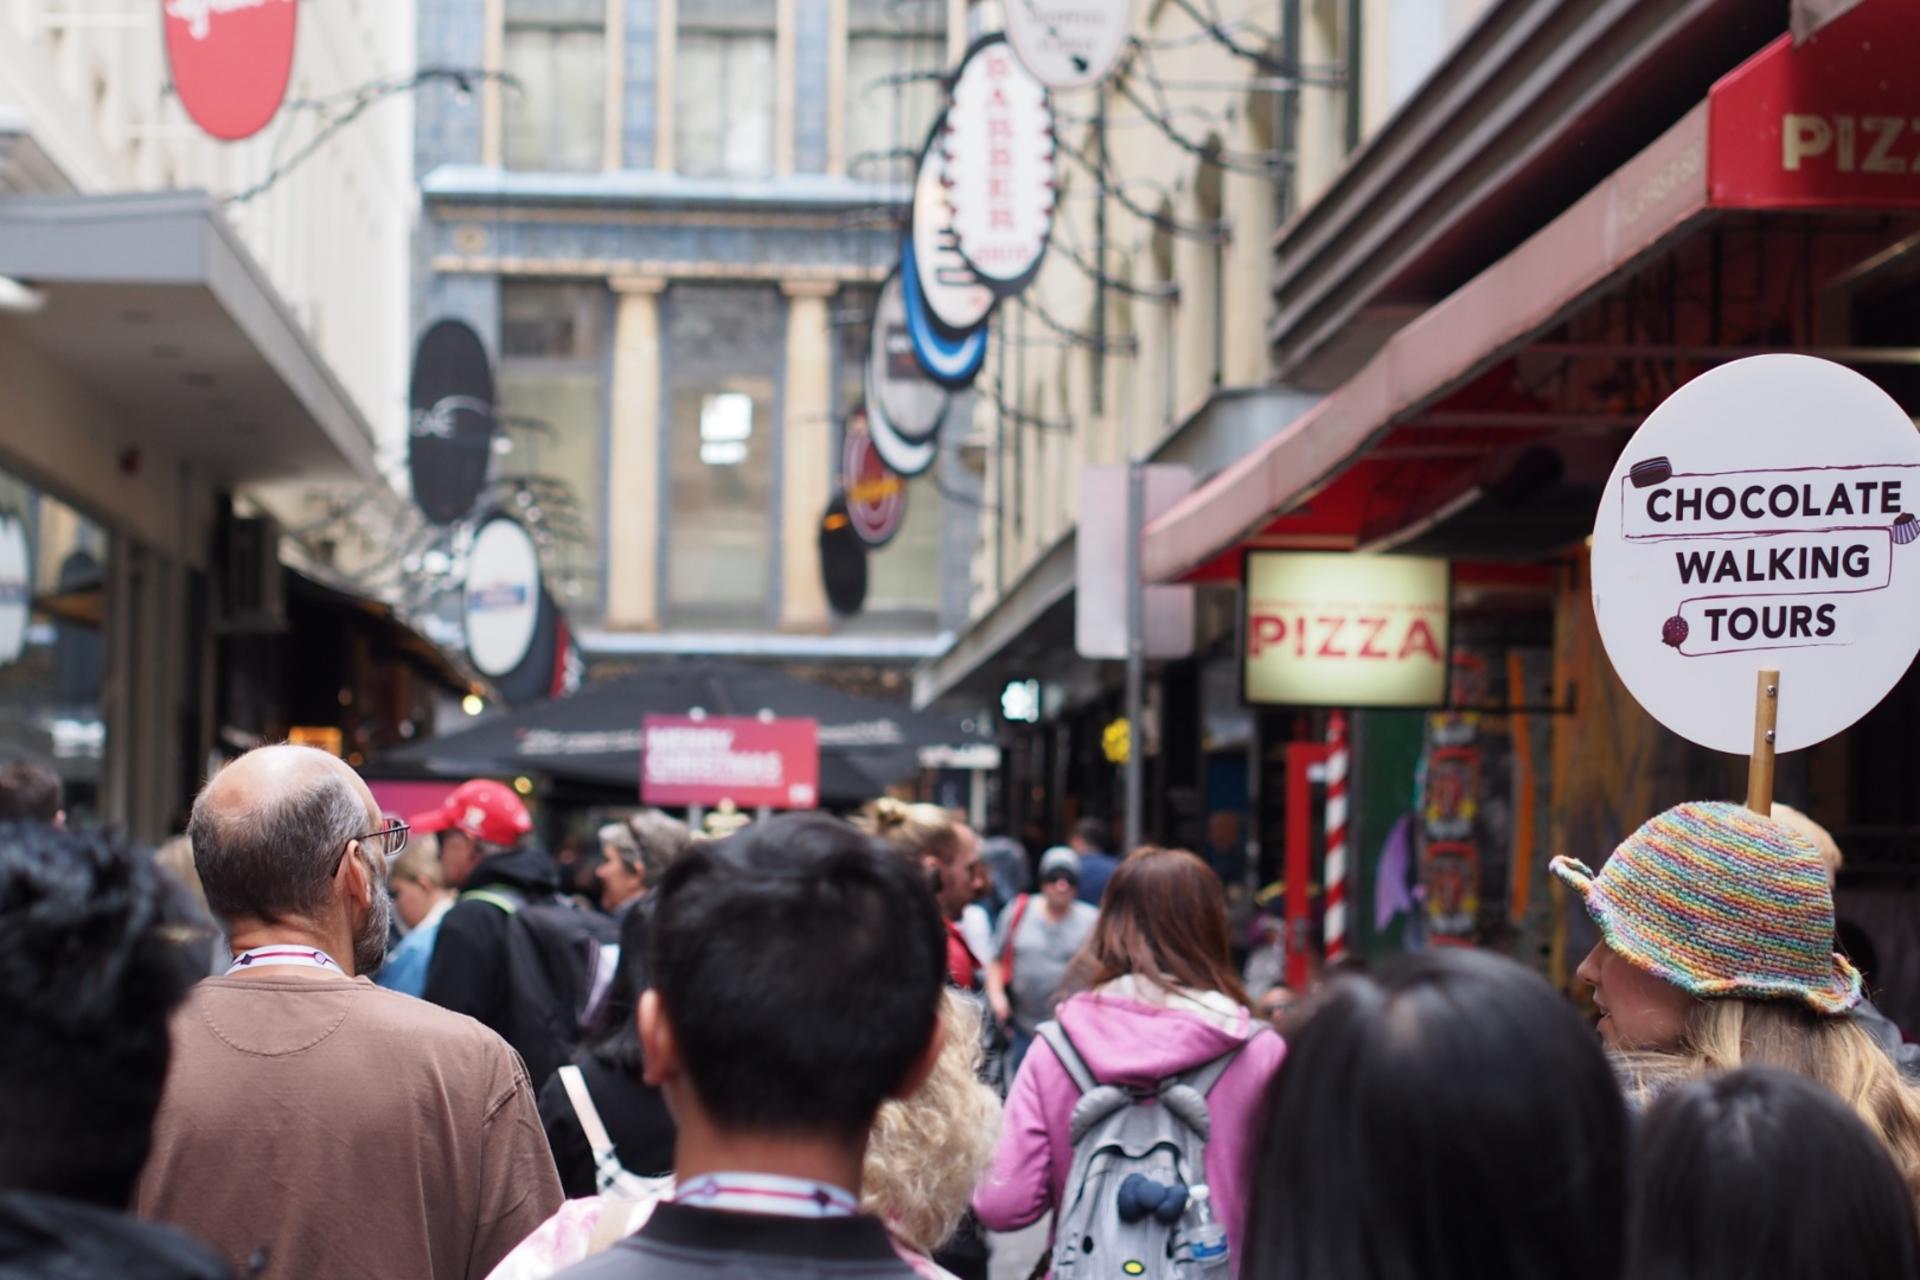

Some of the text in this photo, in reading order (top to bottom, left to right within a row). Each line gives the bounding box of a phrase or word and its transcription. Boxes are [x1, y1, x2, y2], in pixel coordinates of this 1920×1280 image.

[985, 57, 1015, 231] BARBER
[1781, 112, 1920, 173] PIZ
[1646, 481, 1902, 522] CHOCOLATE
[1675, 544, 1870, 584] WALKING
[1249, 614, 1444, 661] PIZZA
[1704, 603, 1836, 642] TOURS
